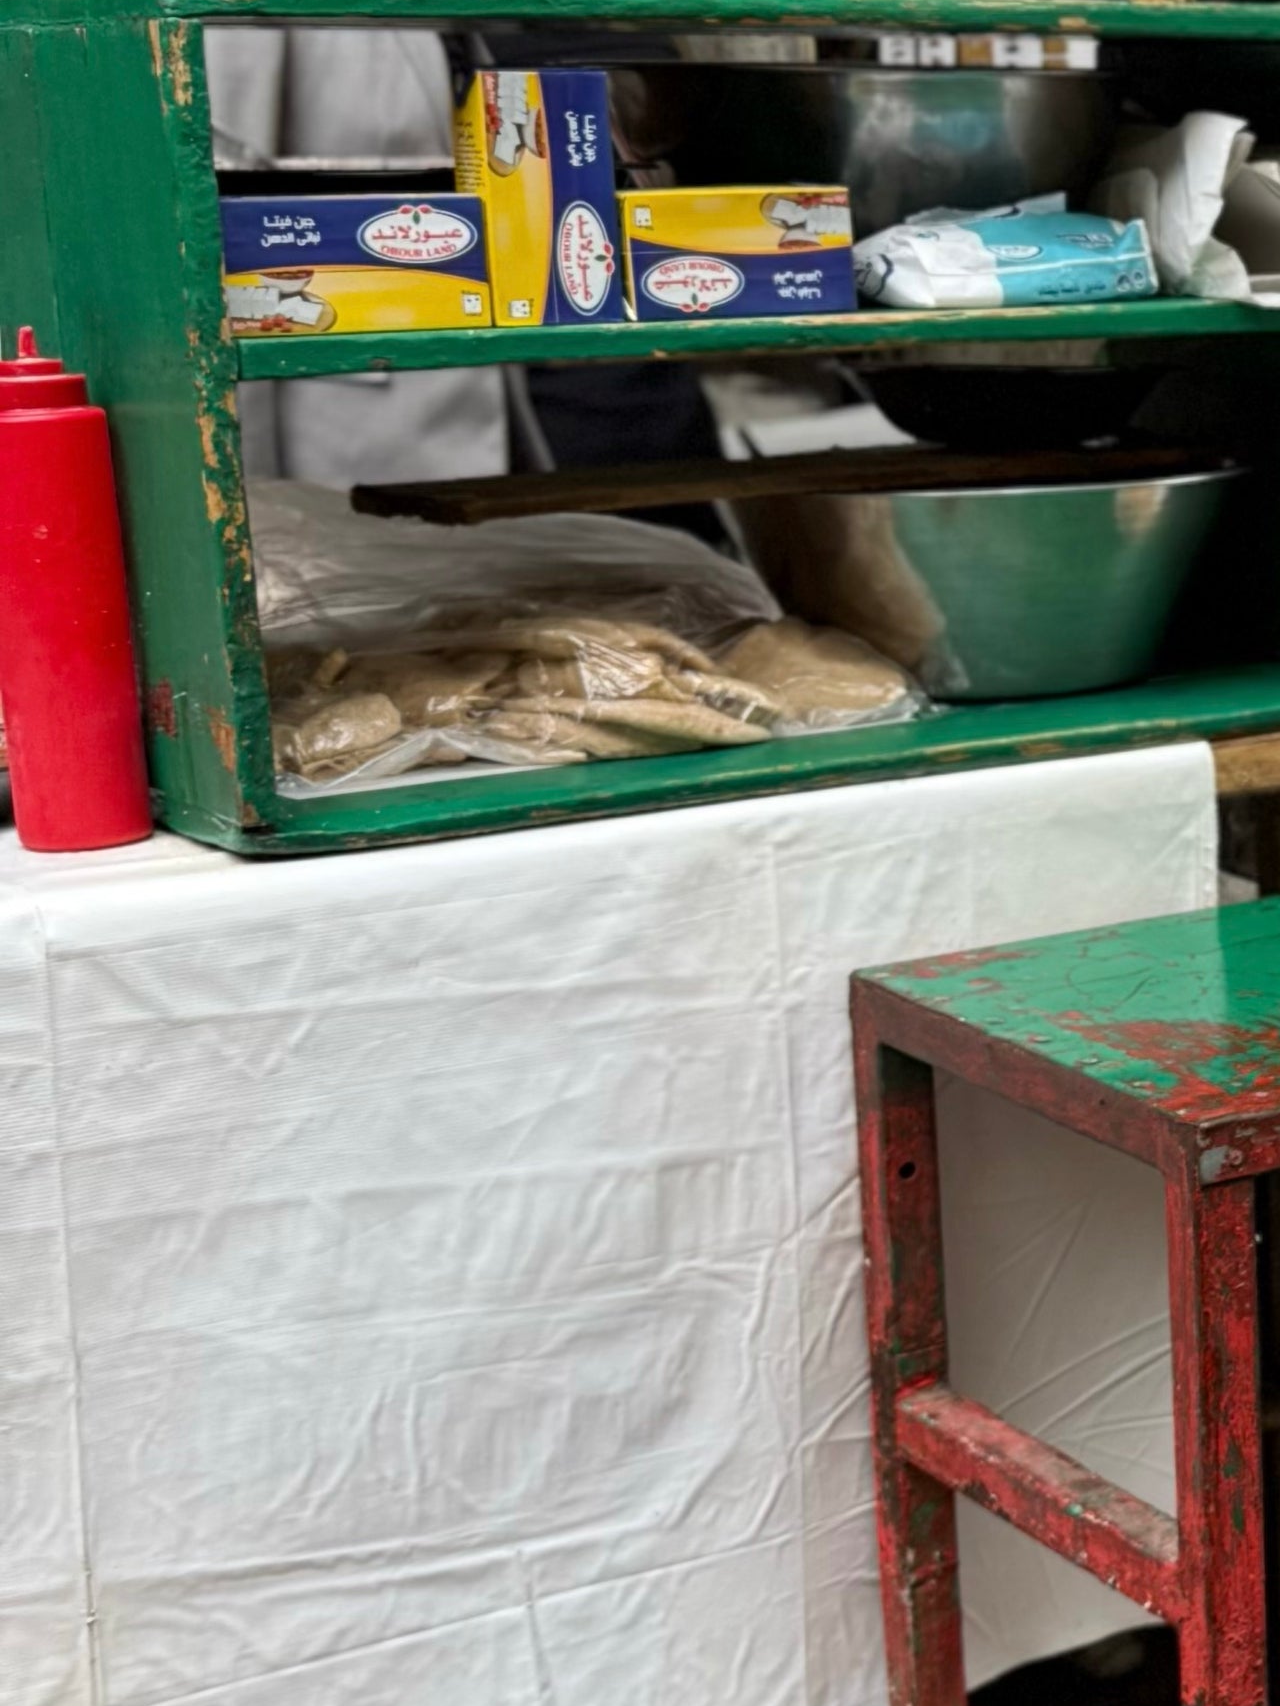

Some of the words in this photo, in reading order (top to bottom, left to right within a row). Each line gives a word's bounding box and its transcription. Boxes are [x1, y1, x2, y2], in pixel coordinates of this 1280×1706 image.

[263, 215, 293, 228] فيتا
[294, 215, 316, 230] جبن
[380, 244, 424, 258] OBOUR
[426, 243, 458, 257] LAND
[562, 222, 575, 264] OBOUR
[658, 262, 687, 276] LAND
[688, 260, 726, 274] OBOUR
[566, 265, 579, 297] LAND
